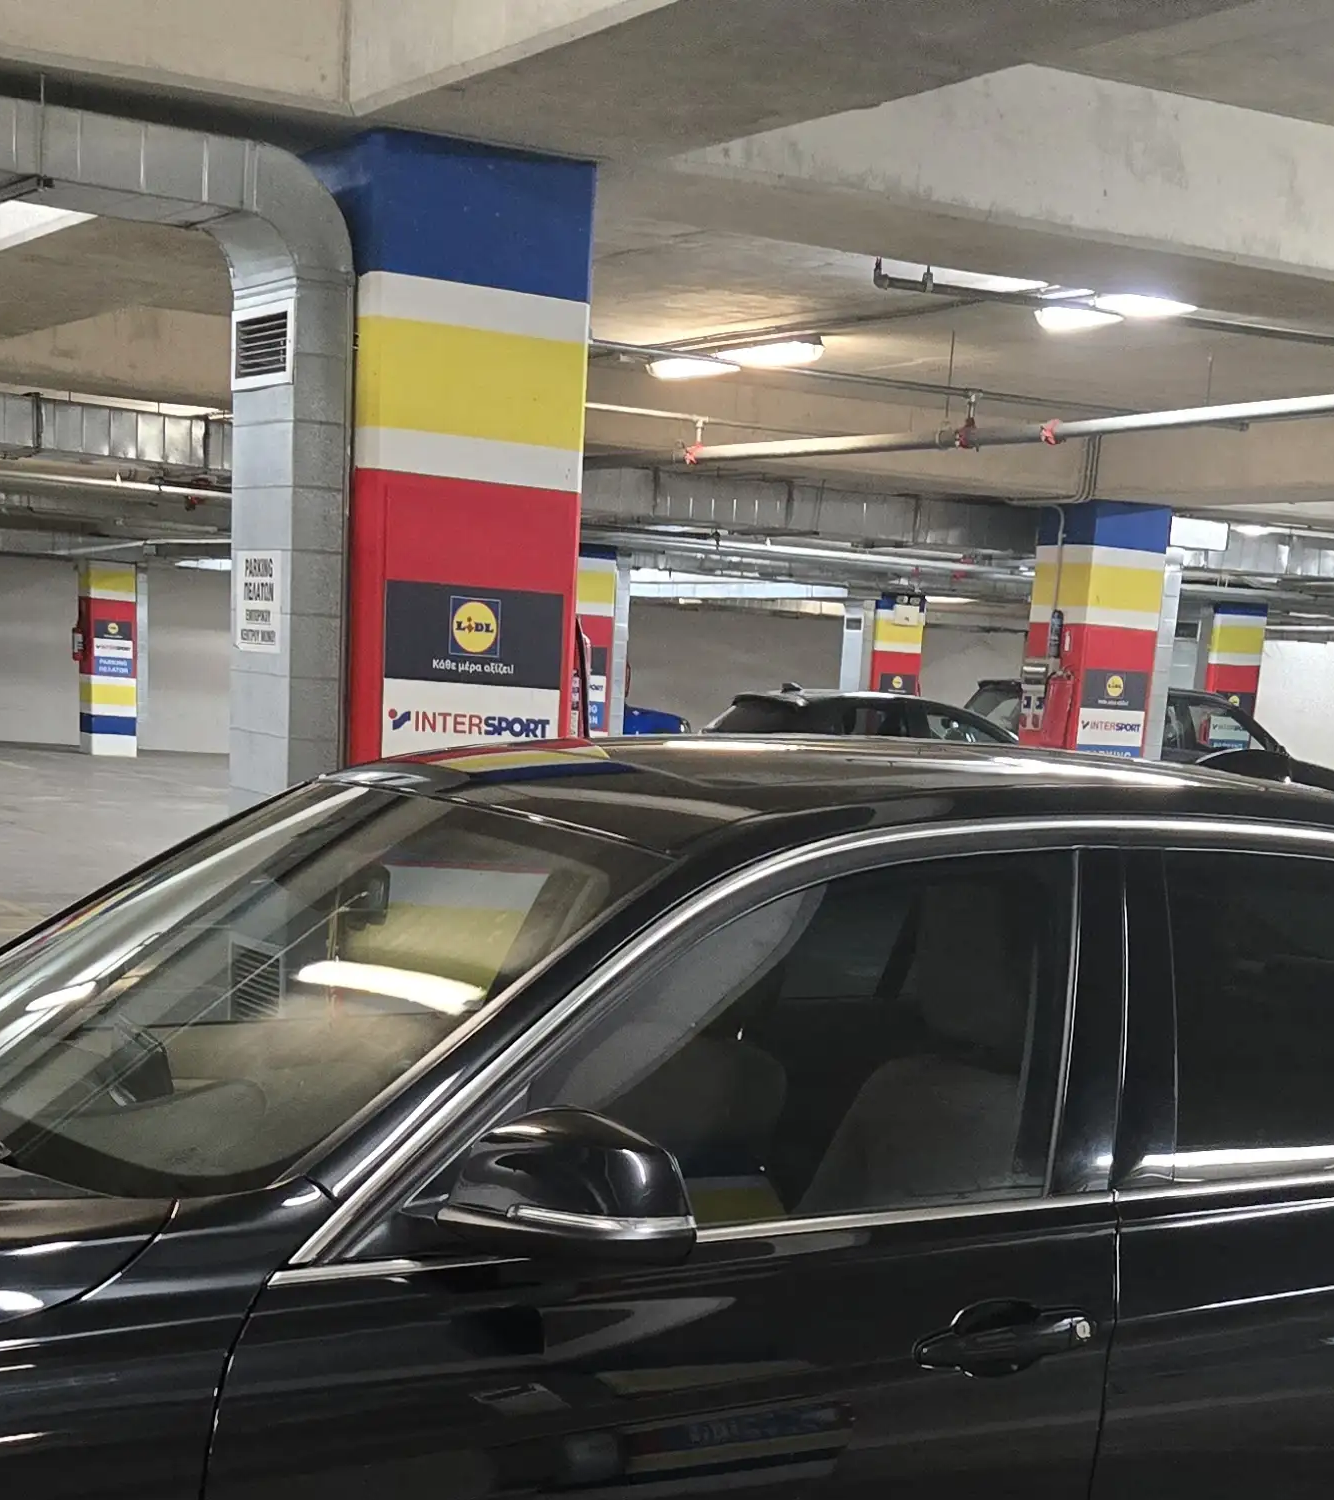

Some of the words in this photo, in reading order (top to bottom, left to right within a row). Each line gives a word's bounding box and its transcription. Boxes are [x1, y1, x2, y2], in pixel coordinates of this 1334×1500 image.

[245, 558, 273, 578] PARKING
[432, 658, 457, 670] Κάθε
[458, 661, 482, 673] μέρα
[414, 710, 550, 739] INTERSPORT
[1090, 720, 1141, 733] INTERSPORT
